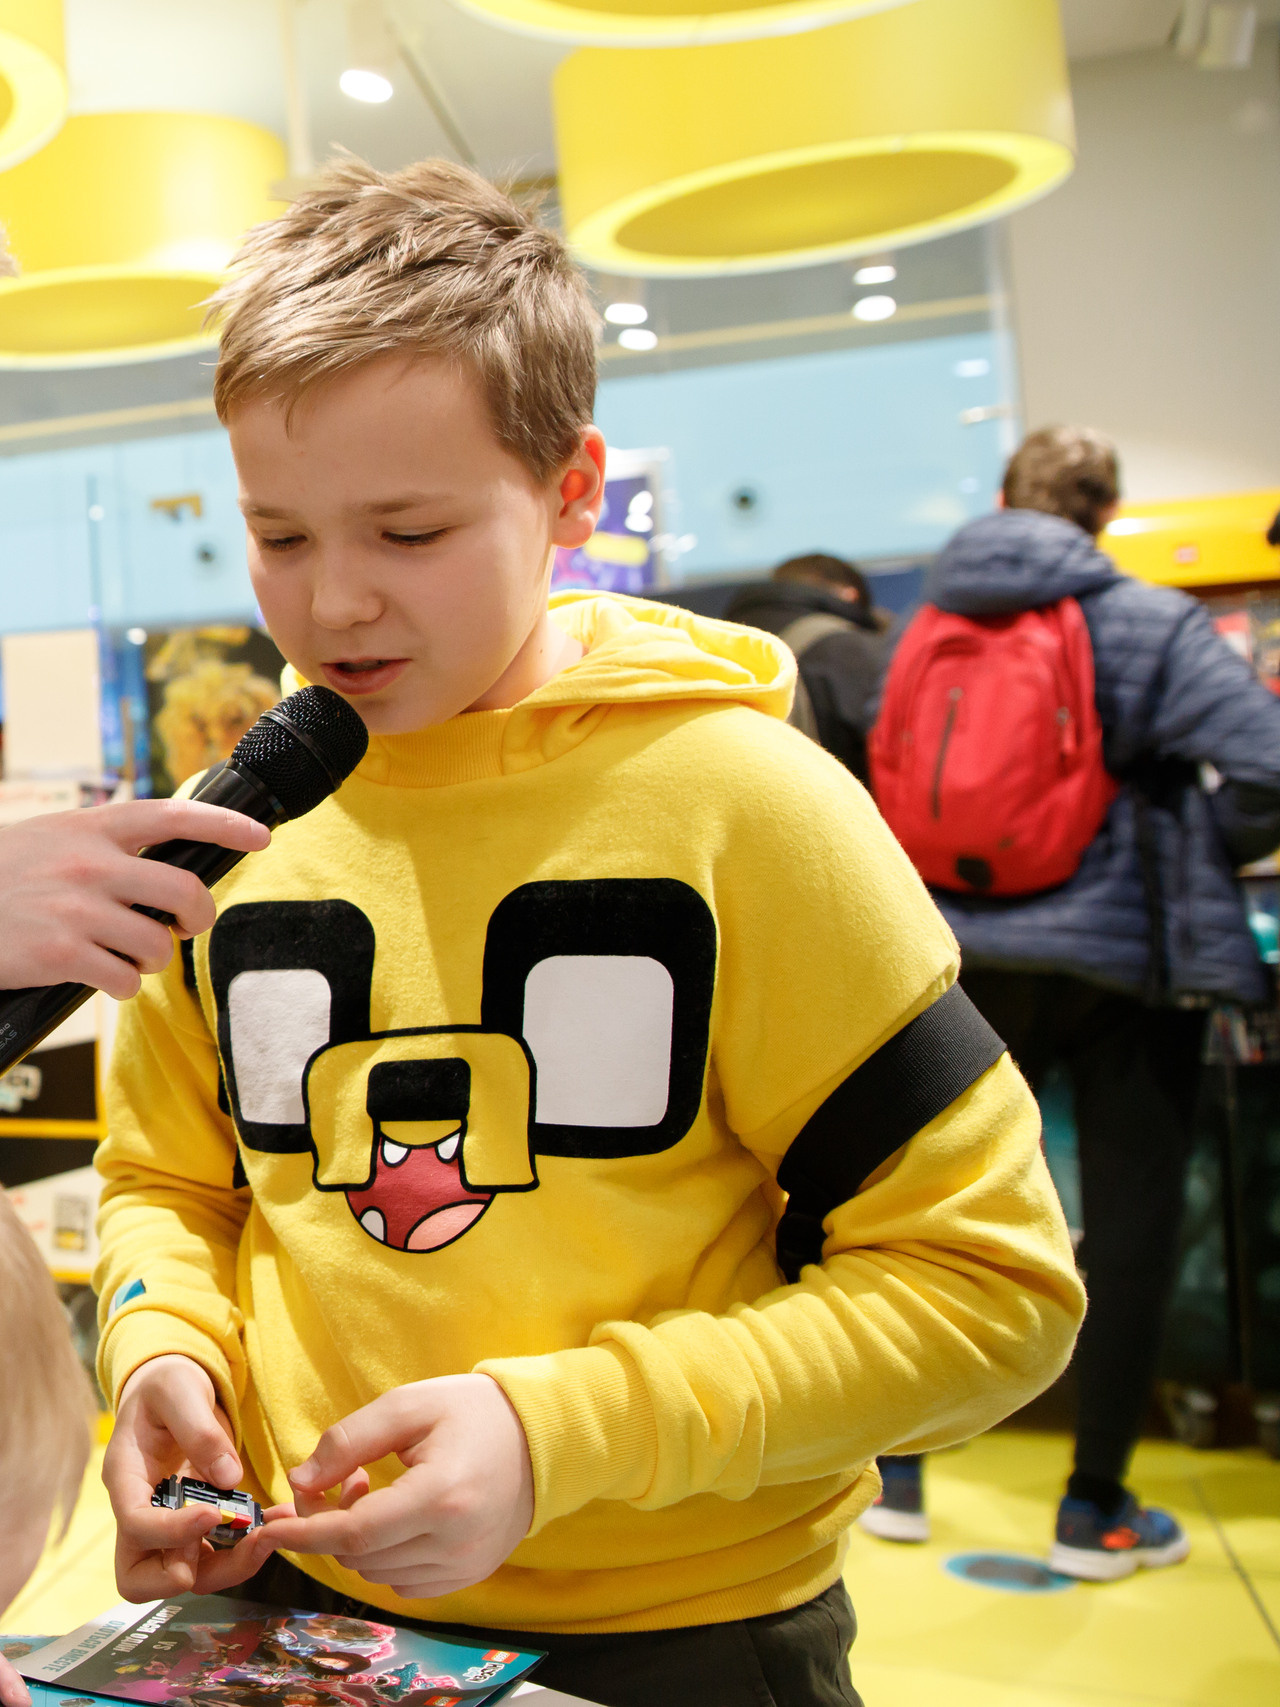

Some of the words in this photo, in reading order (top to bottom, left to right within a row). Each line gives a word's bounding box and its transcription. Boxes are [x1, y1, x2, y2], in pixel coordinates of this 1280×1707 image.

[136, 1605, 183, 1634] ОХОТЬСЯ
[78, 1620, 126, 1649] ОХОТЬСЯ
[42, 1648, 89, 1672] ВМЕСТЕ
